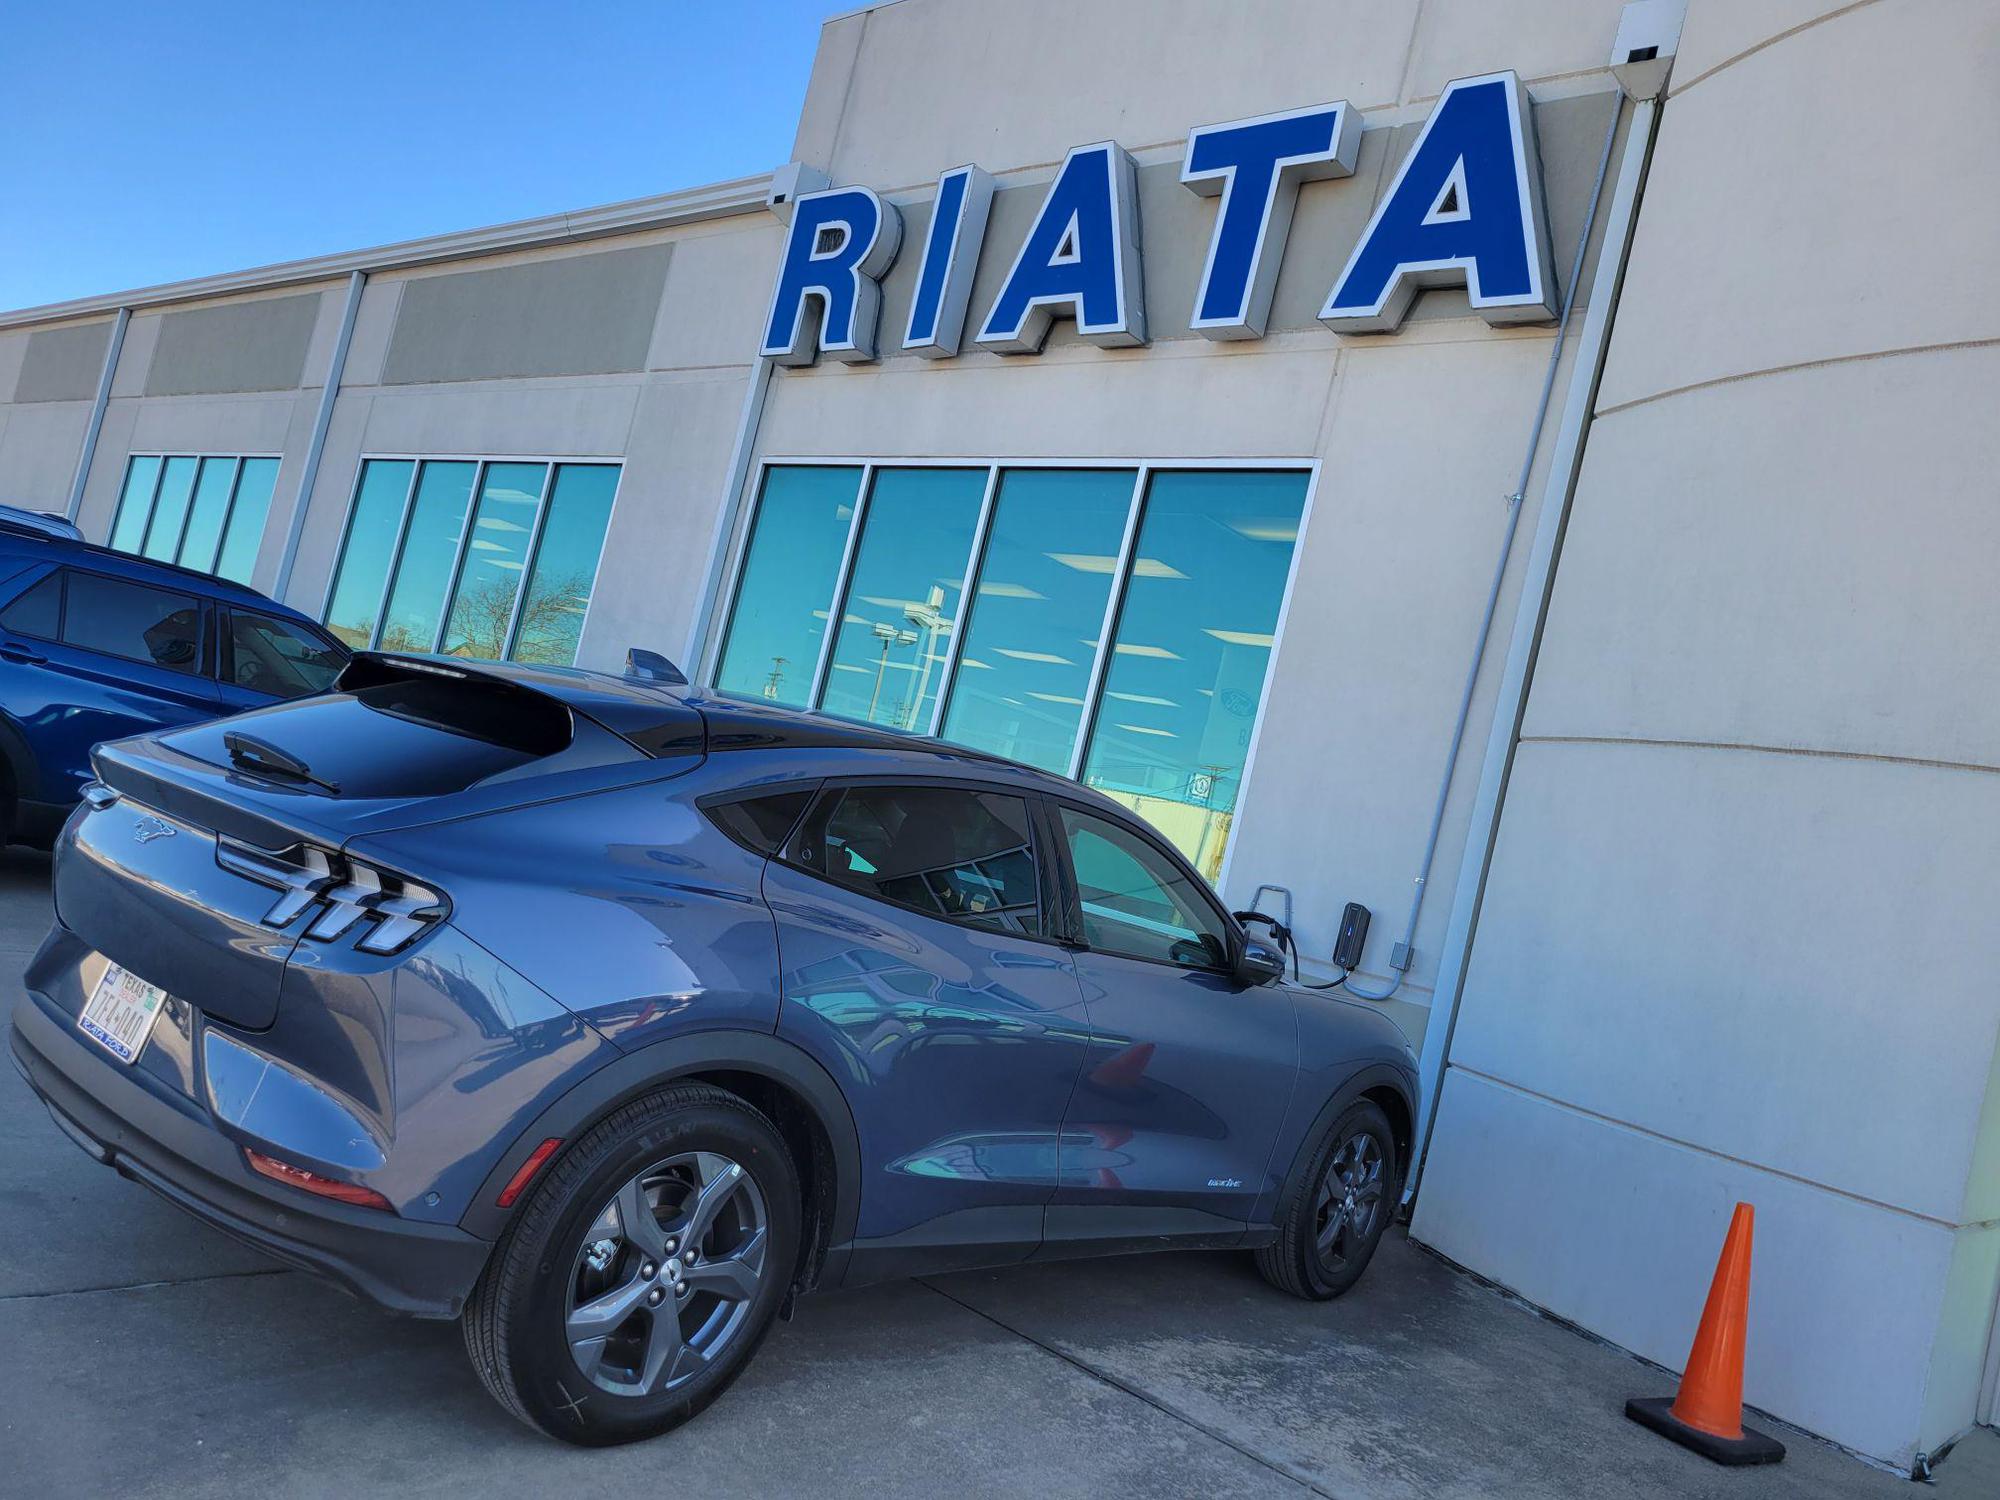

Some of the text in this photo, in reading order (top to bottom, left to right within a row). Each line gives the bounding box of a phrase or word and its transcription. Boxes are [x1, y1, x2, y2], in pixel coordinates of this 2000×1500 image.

[760, 69, 1554, 364] RIATA
[121, 973, 146, 998] TEXAS
[83, 1019, 129, 1056] RIATA FORD
